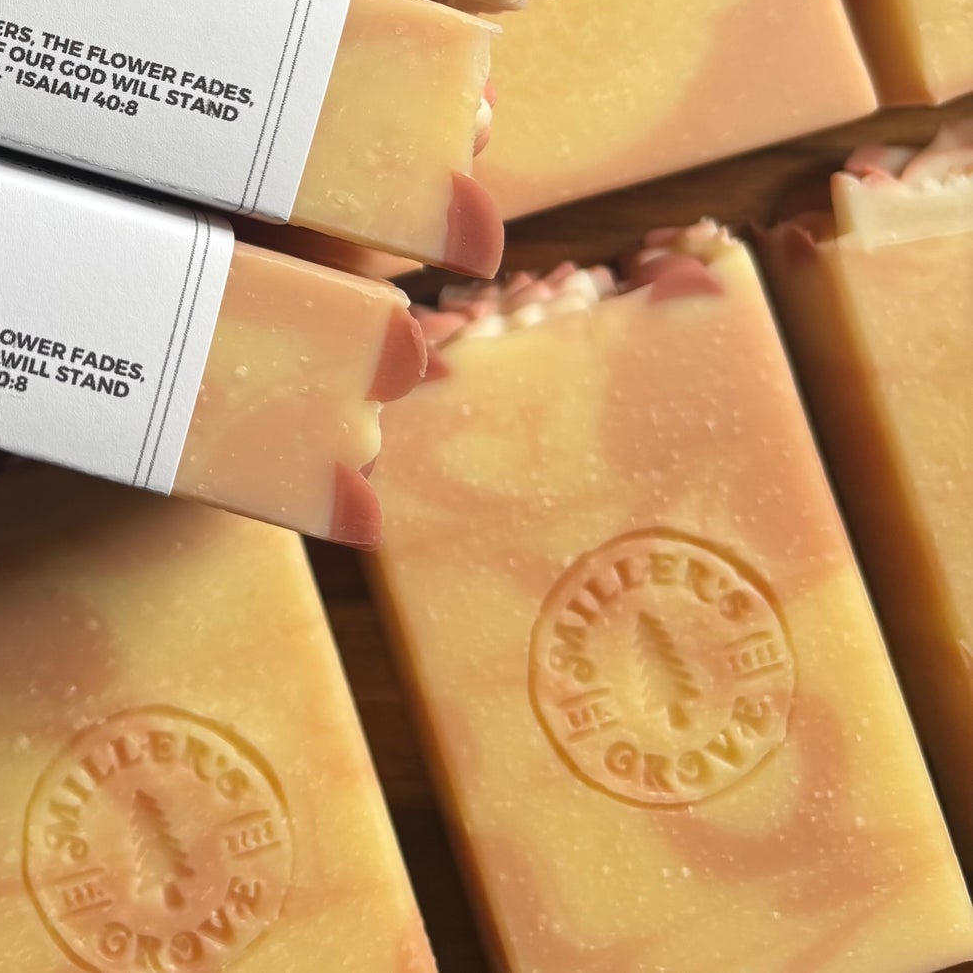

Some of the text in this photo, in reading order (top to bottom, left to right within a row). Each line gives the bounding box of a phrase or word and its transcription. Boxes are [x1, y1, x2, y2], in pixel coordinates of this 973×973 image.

[8, 45, 56, 72] OUR
[58, 59, 108, 86] GOD
[111, 72, 161, 102] WILL
[164, 89, 240, 122] STAND
[15, 68, 91, 104] ISAIAH
[92, 90, 139, 117] 40:8
[41, 31, 85, 59] THE
[85, 44, 178, 85] FLOWER
[179, 70, 255, 108] FADES,
[1, 349, 51, 379] WILL
[54, 364, 130, 399] STAND
[69, 346, 146, 384] FADES,
[604, 696, 771, 792] GROVE
[99, 877, 262, 972] GROVE
